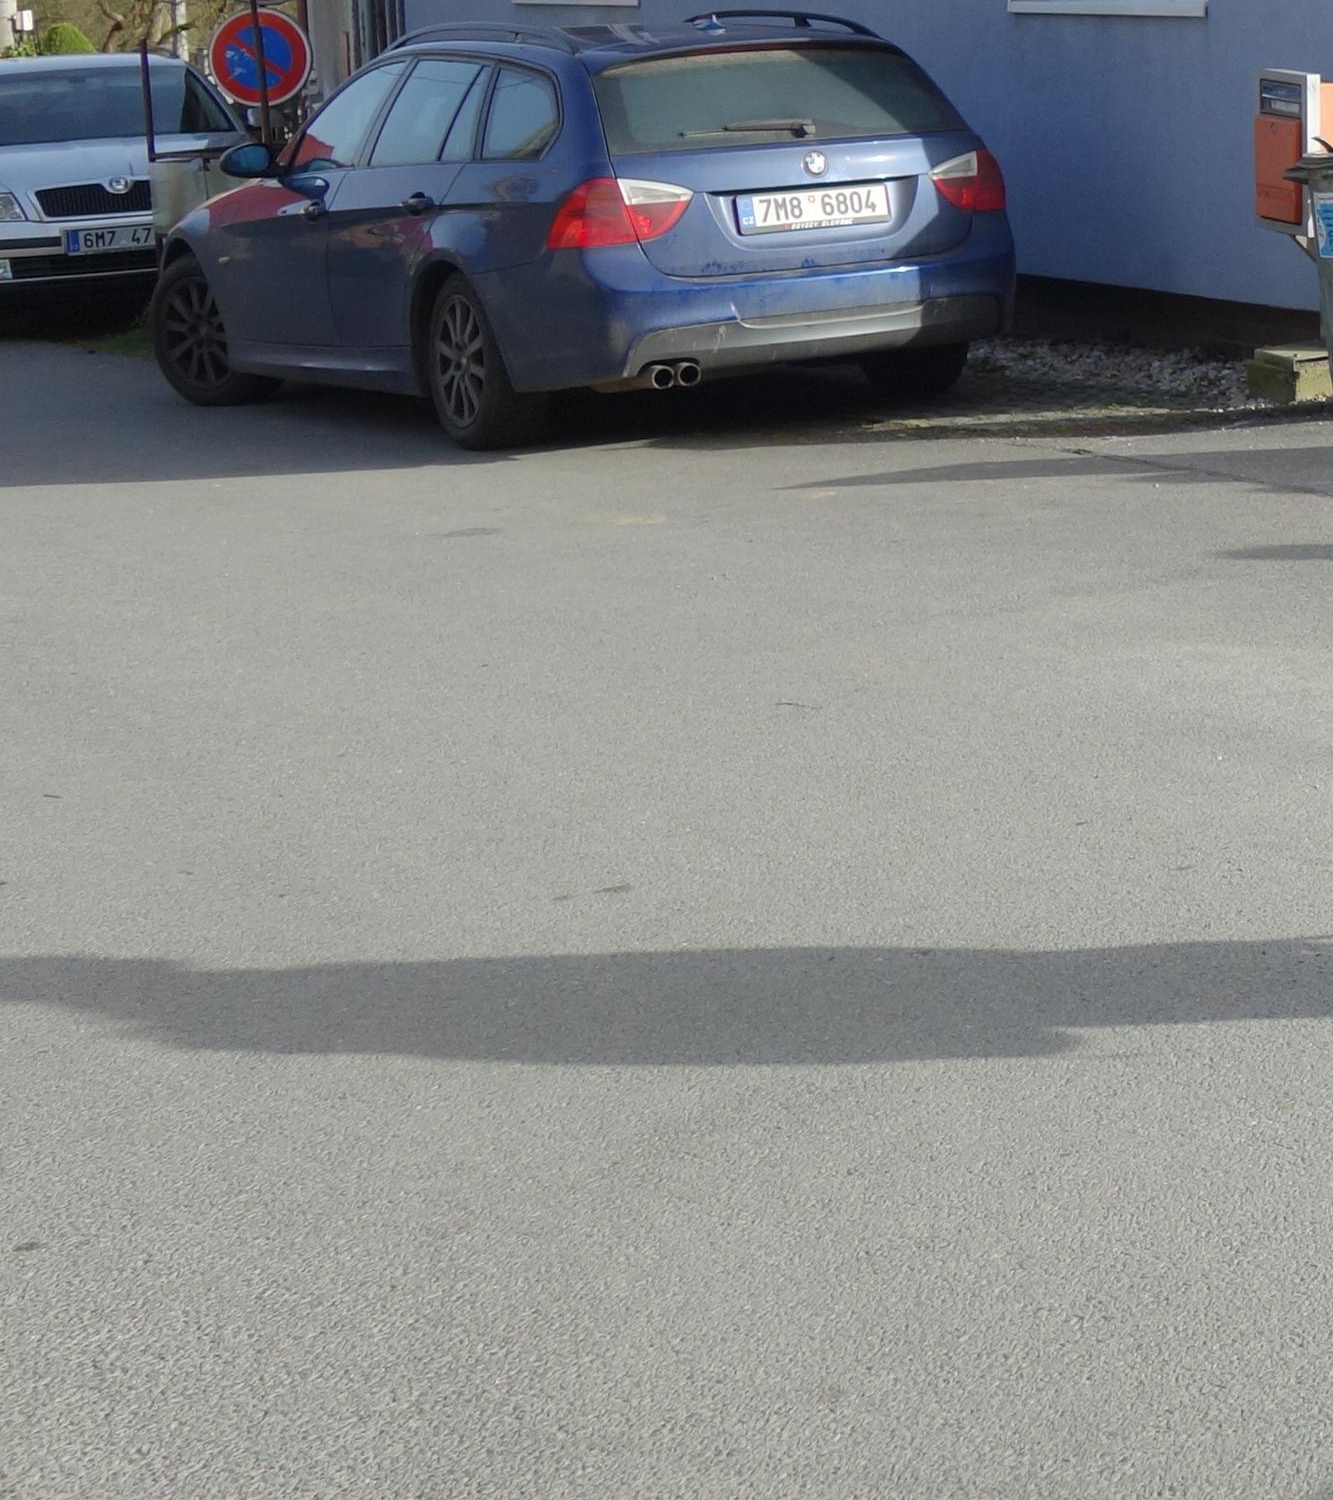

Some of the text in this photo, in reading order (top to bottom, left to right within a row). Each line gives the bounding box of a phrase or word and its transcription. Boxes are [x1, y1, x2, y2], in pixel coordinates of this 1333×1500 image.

[758, 189, 878, 223] 7M8 6804
[131, 227, 151, 245] 47
